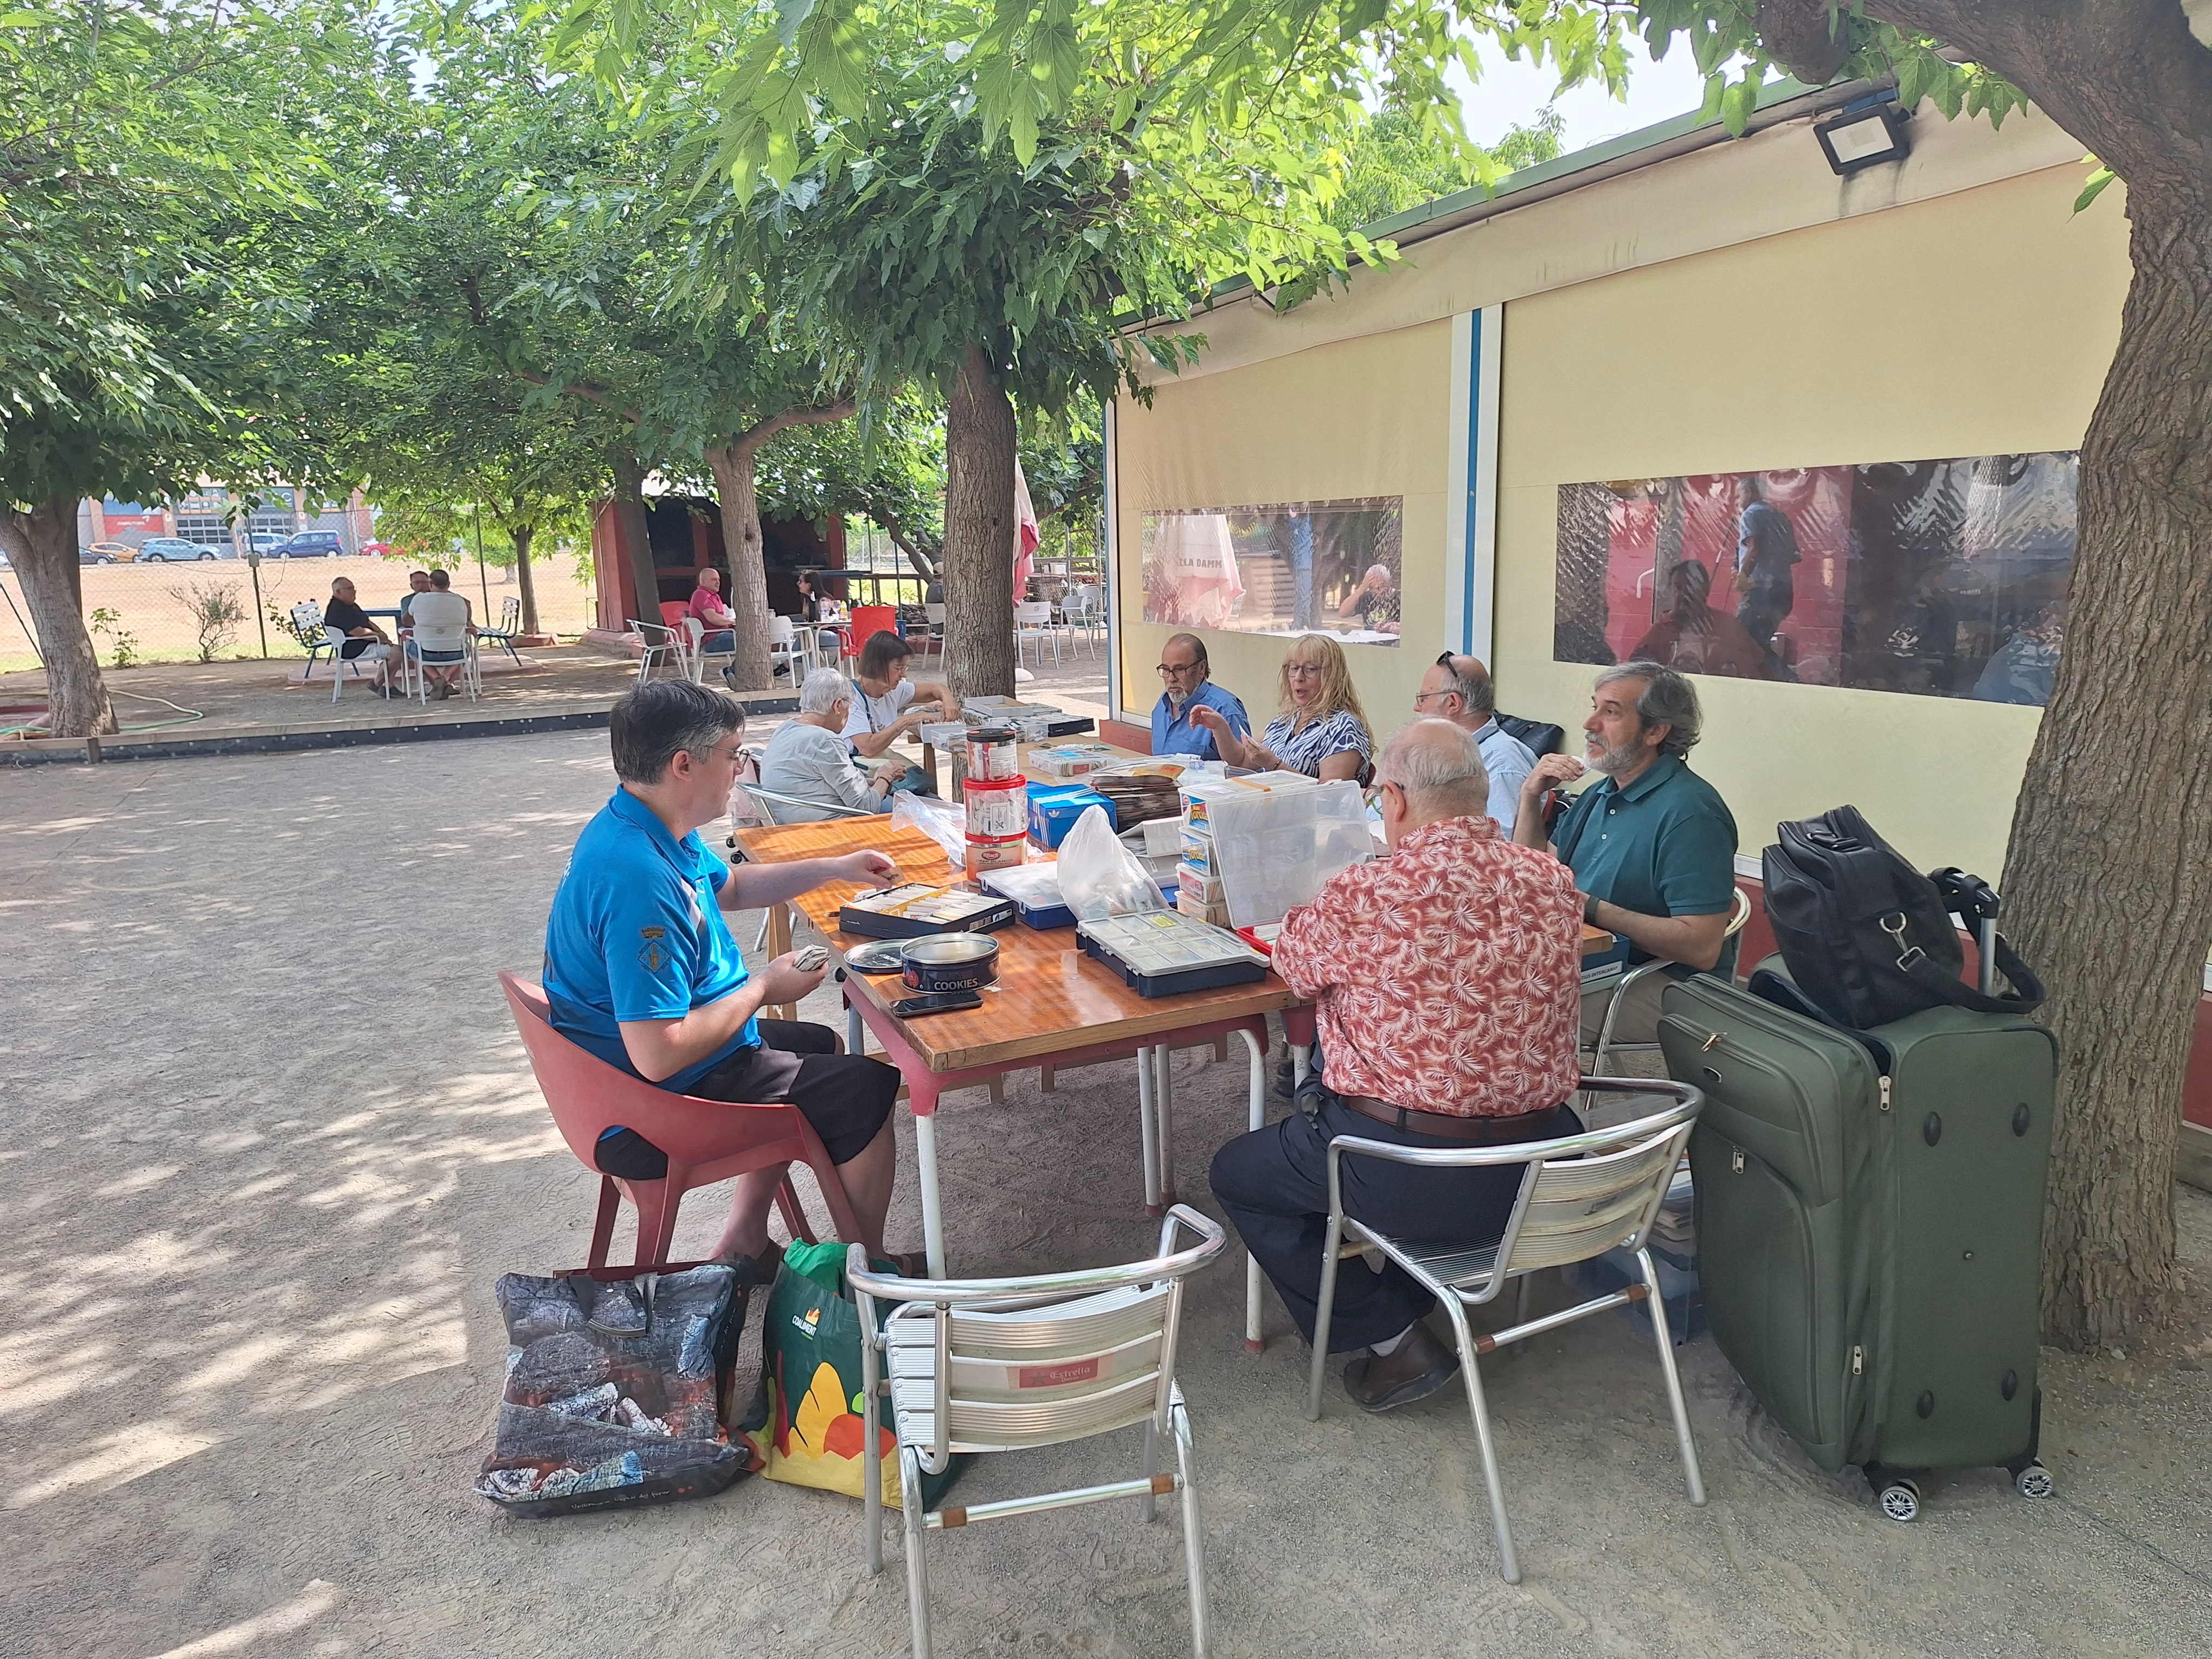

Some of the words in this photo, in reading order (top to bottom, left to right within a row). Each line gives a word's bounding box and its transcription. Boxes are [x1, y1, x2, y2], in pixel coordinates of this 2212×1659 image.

[1197, 559, 1221, 568] DAMM
[934, 978, 978, 991] COOKIES
[792, 1315, 817, 1336] COALIMENT
[1050, 1367, 1090, 1379] Estrella
